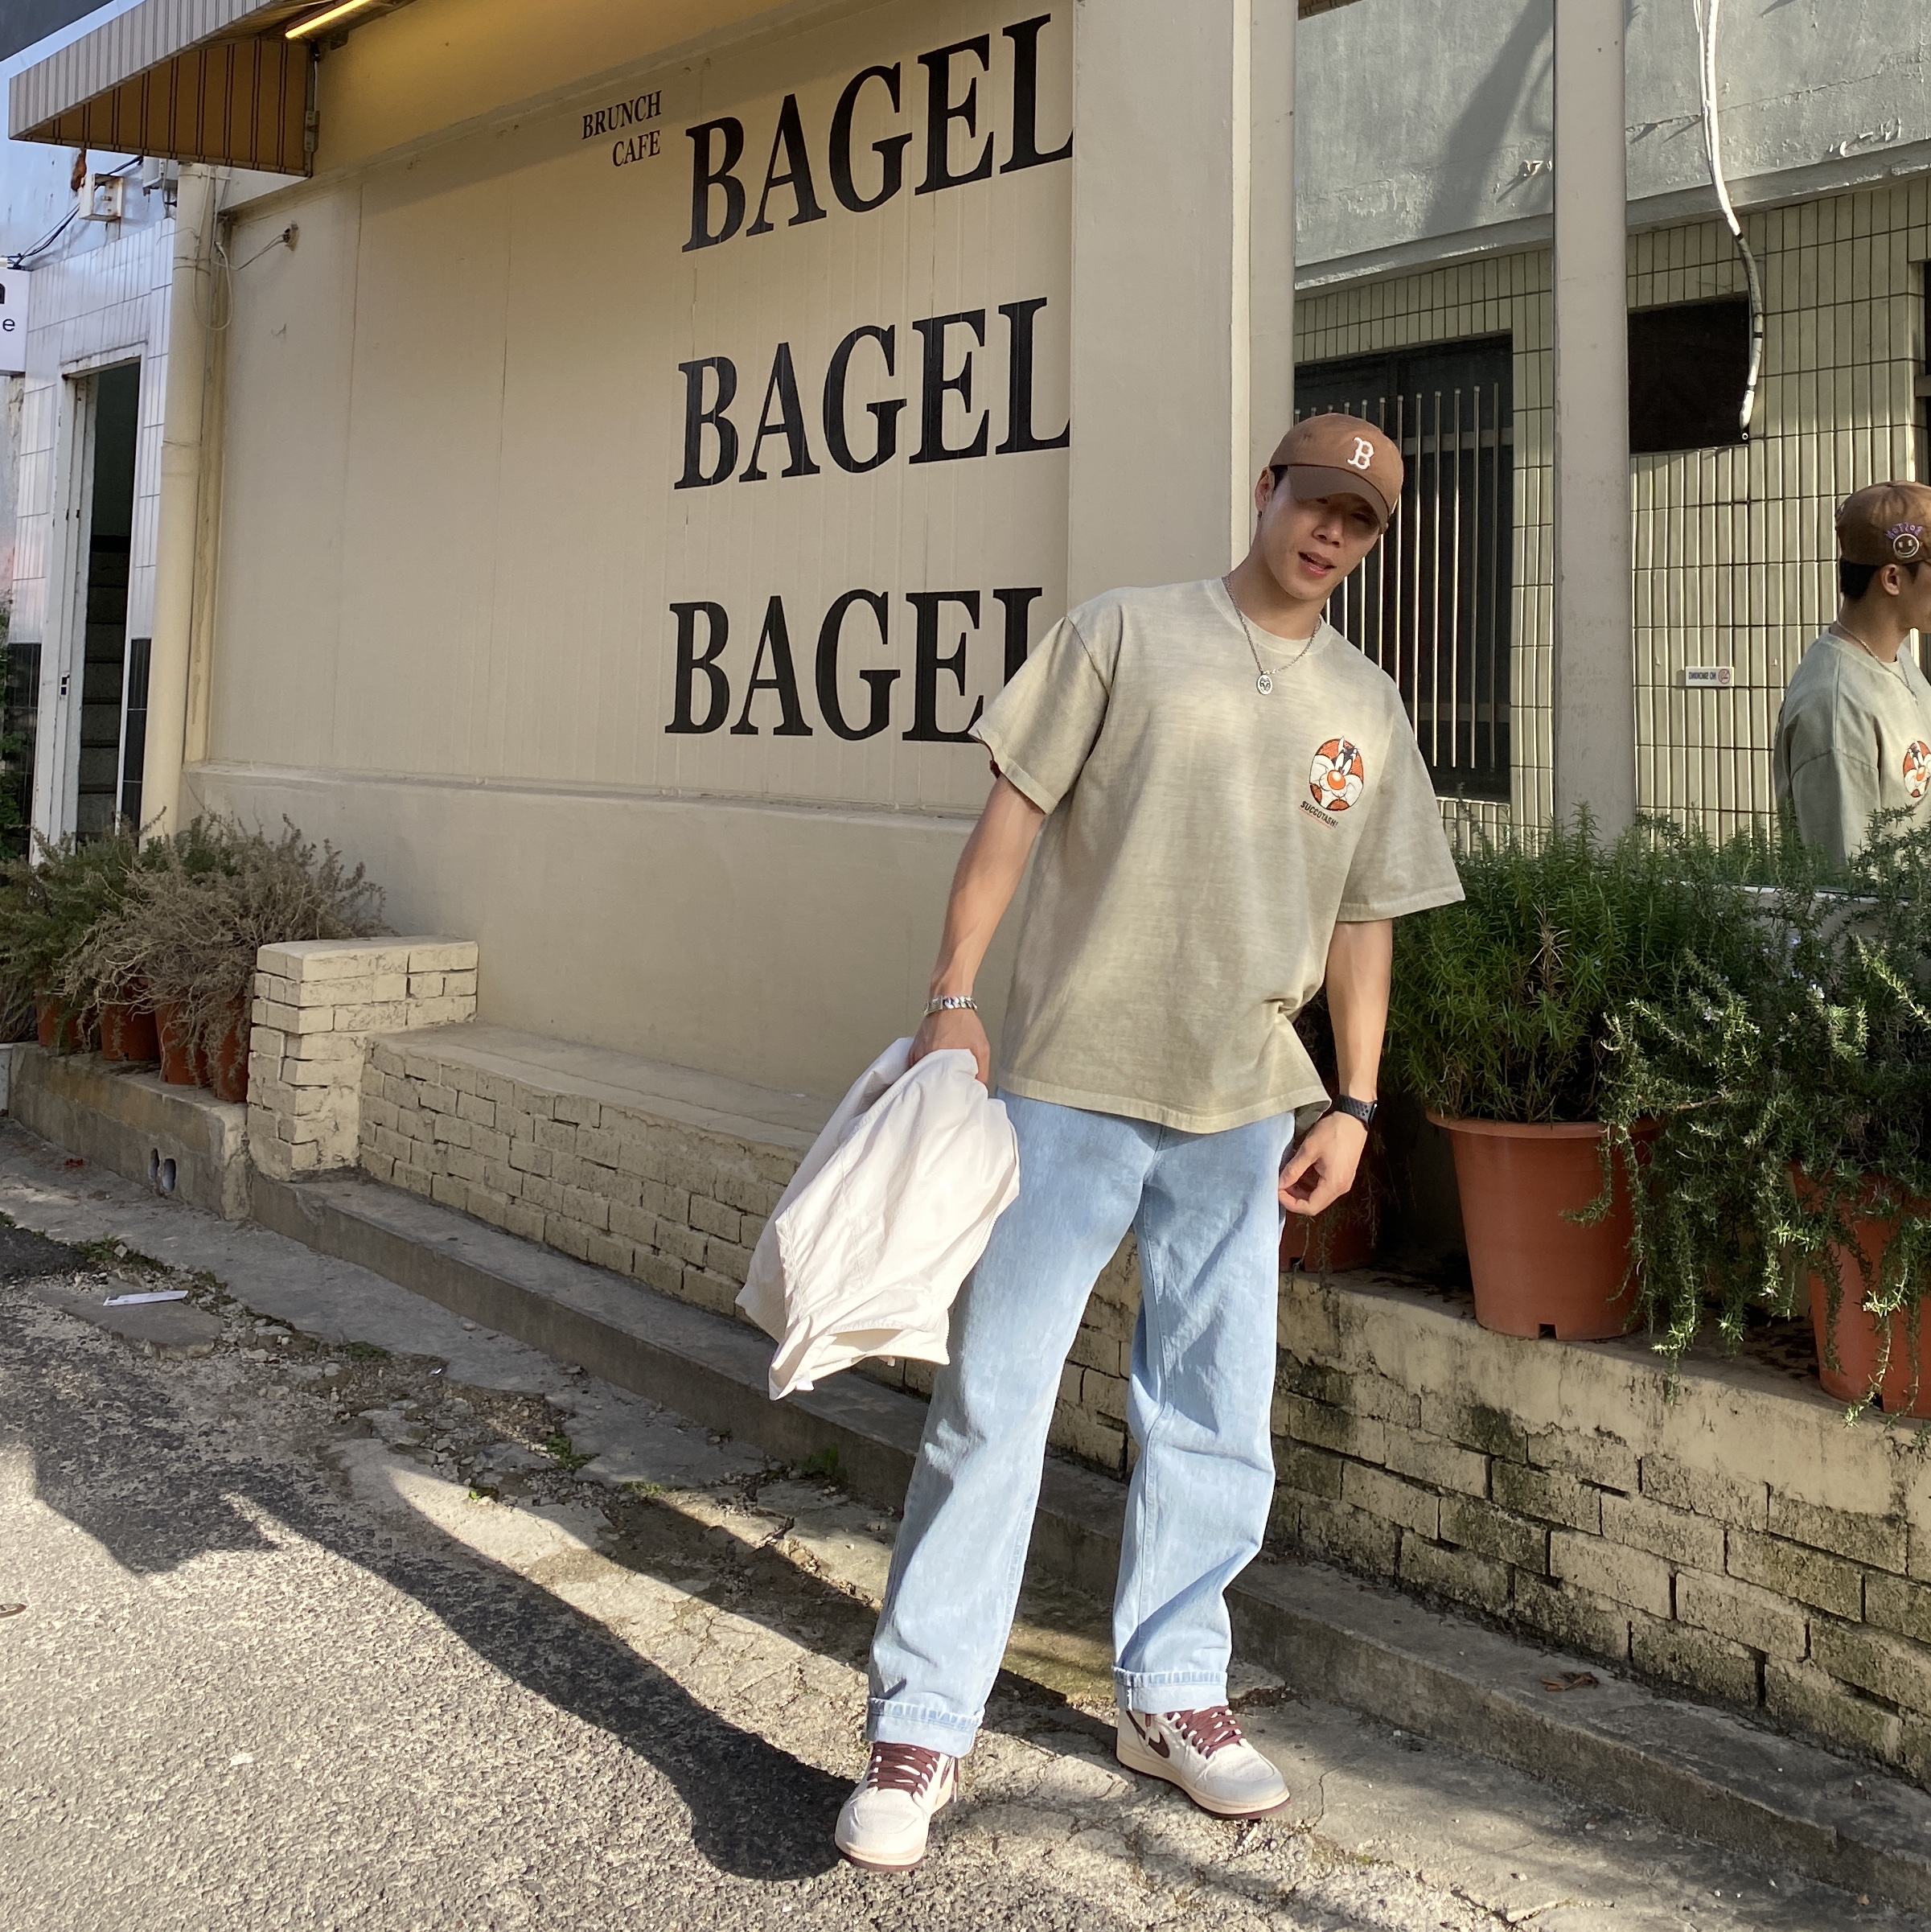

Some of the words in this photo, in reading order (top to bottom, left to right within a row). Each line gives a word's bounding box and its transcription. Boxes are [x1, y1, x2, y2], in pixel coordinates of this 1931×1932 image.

[581, 89, 662, 140] BRUNCH
[682, 13, 1074, 253] BAGEL
[613, 129, 660, 166] CAFE
[674, 297, 1070, 489] BAGEL
[1347, 437, 1374, 470] B
